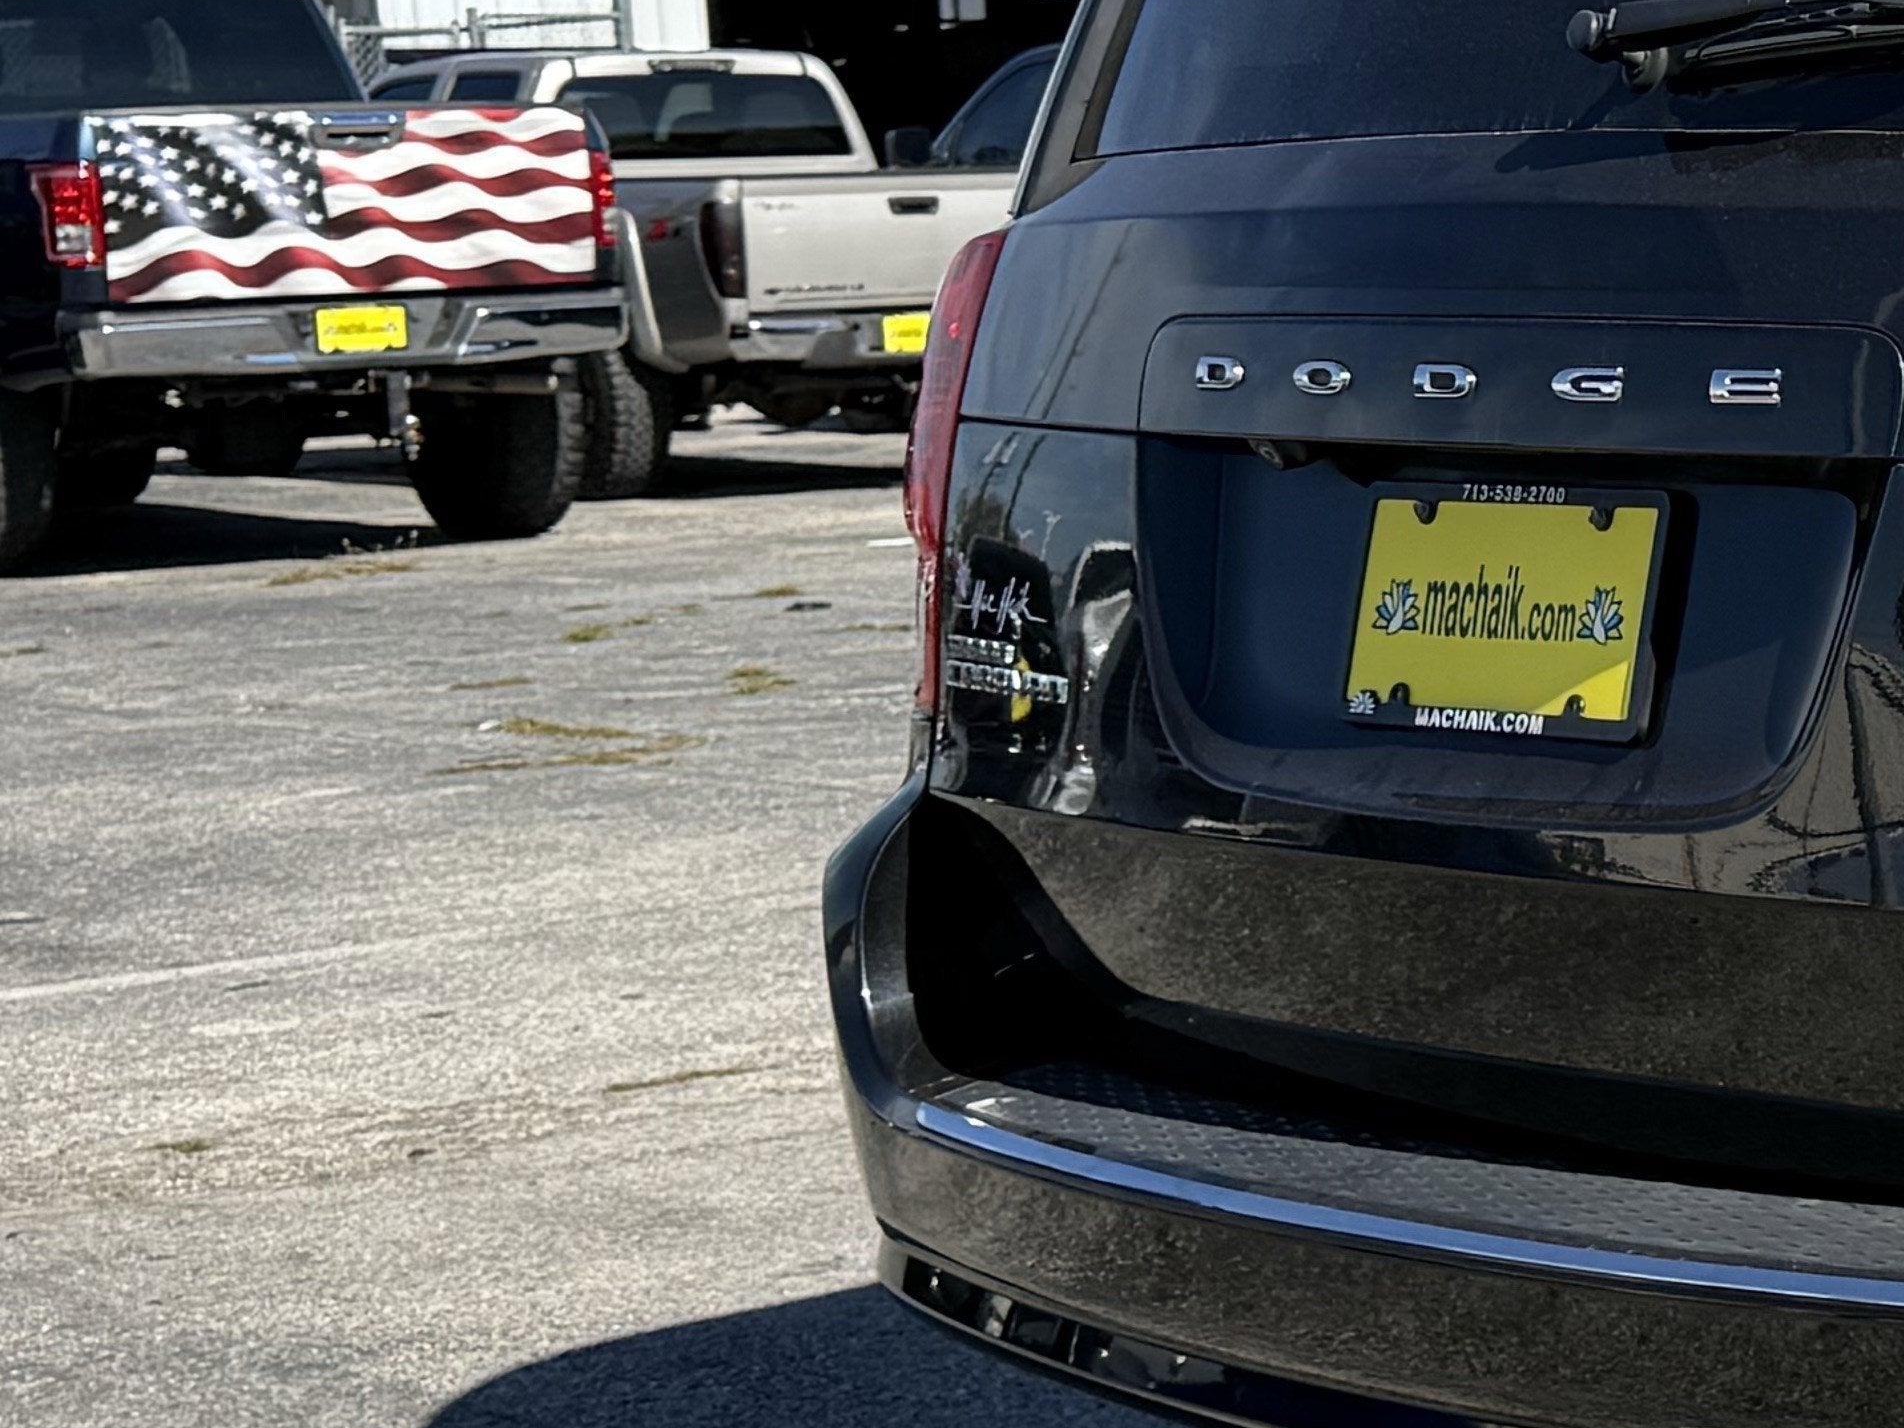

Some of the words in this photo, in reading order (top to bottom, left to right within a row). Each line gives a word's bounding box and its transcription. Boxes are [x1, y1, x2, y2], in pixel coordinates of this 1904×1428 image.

[1195, 355, 1783, 406] DODGE
[1420, 563, 1577, 643] machaik.com
[1414, 707, 1545, 736] MACHAIK.COM
